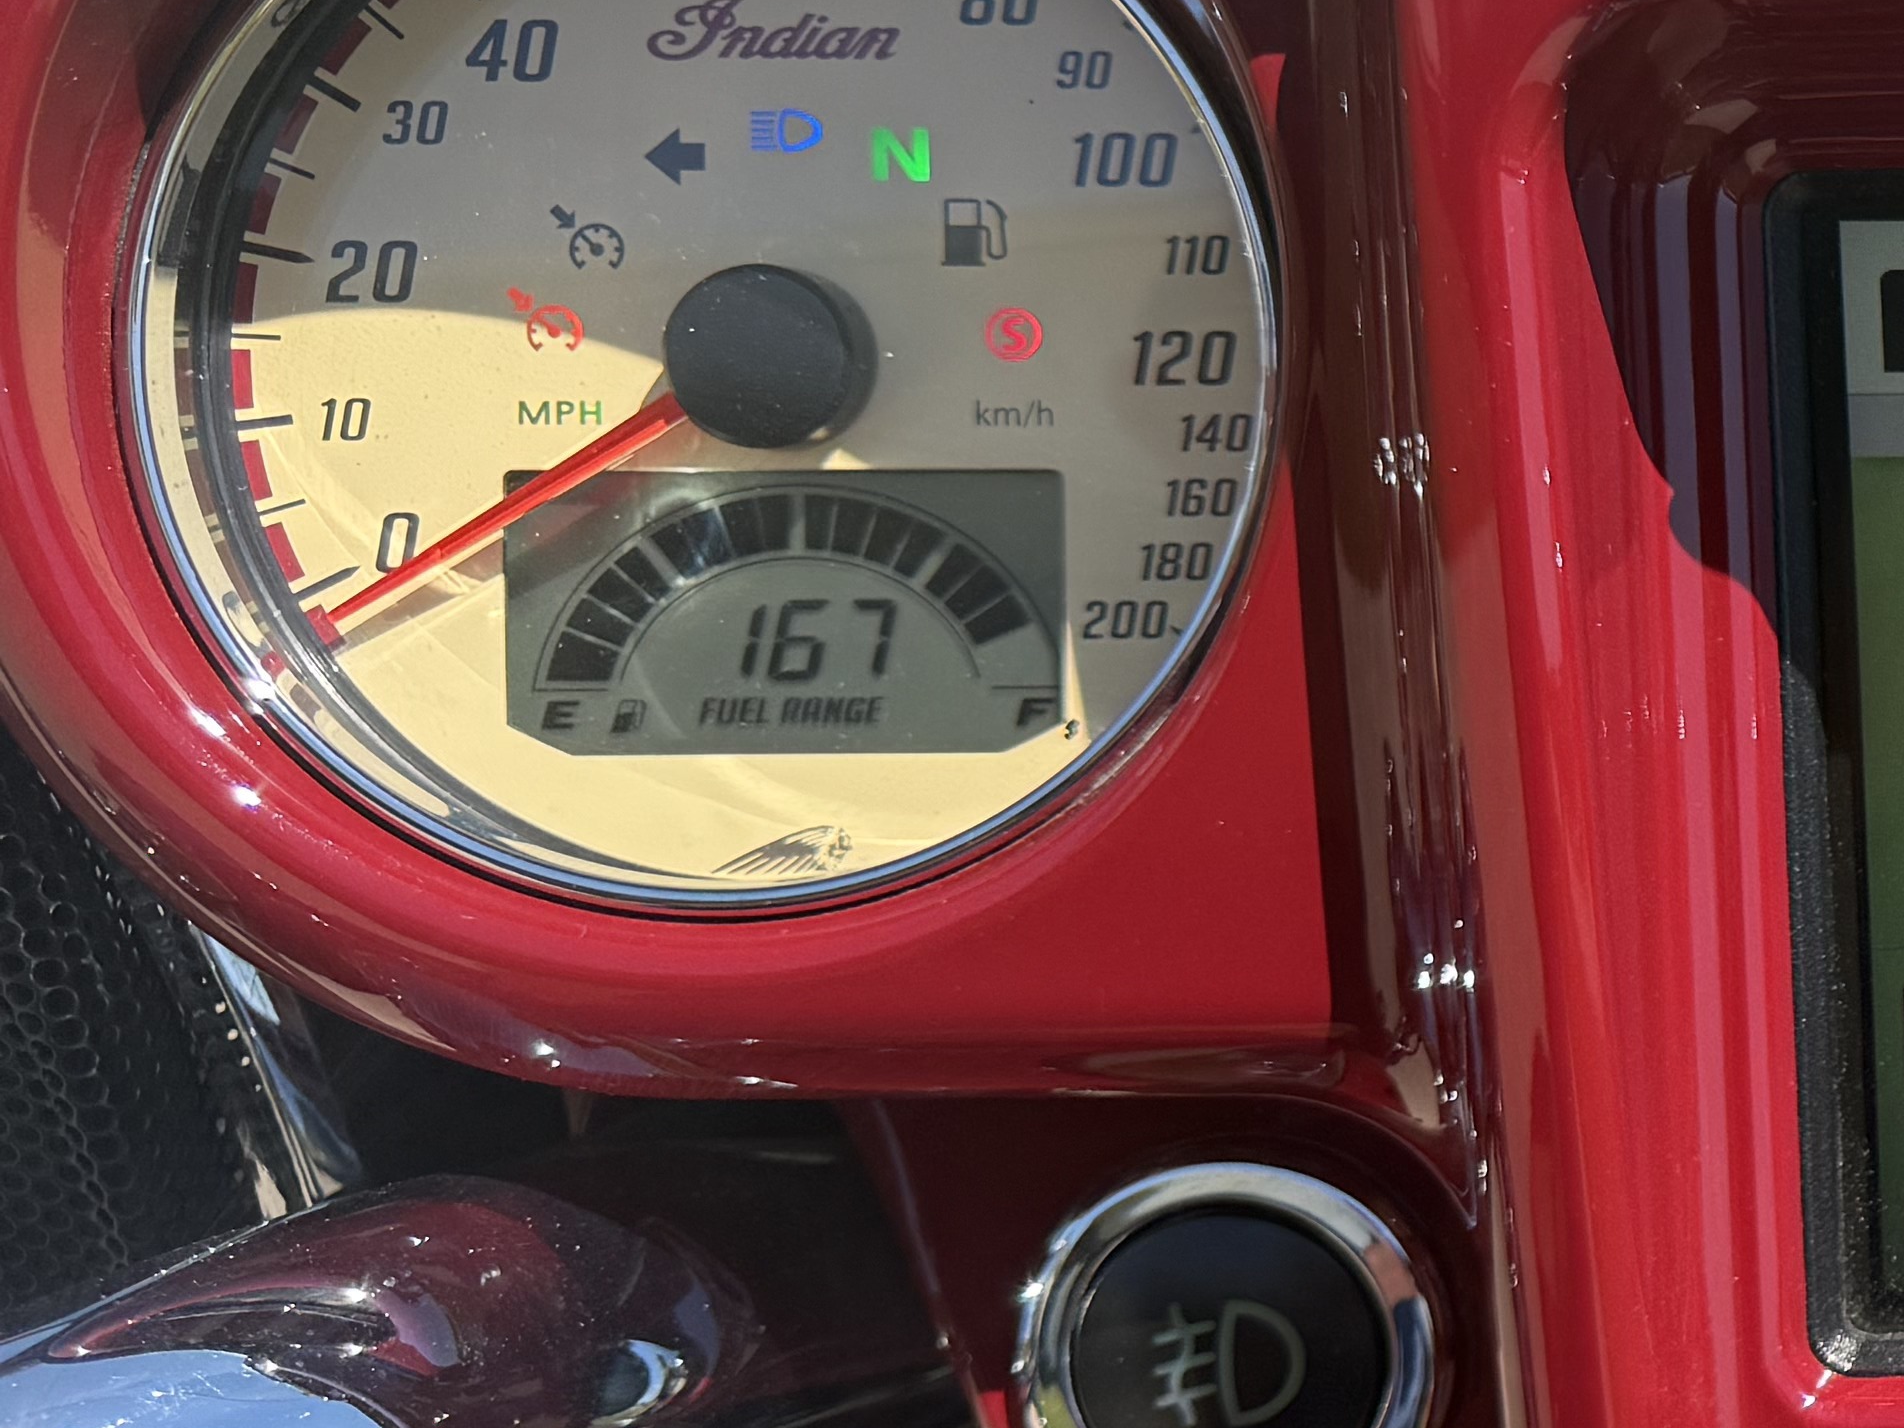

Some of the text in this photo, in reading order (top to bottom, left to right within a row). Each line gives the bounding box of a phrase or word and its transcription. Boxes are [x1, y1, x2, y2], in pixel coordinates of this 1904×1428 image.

[466, 19, 558, 82] 40
[1055, 51, 1112, 91] 90
[382, 100, 448, 146] 30
[870, 128, 931, 182] N
[1073, 132, 1177, 188] 100
[326, 240, 417, 302] 20
[1164, 236, 1230, 275] 110
[1133, 332, 1236, 388] 120
[321, 399, 371, 440] 10
[517, 401, 602, 425] MPH
[974, 398, 1054, 428] km/h
[1180, 414, 1250, 454] 140
[1164, 478, 1237, 518] 160
[376, 512, 417, 573] 0
[1139, 542, 1211, 582] 180
[1083, 601, 1169, 640] 200
[740, 600, 895, 684] 167
[541, 700, 580, 730] E
[700, 696, 884, 726] FUEL RANGE
[1016, 698, 1058, 727] F
